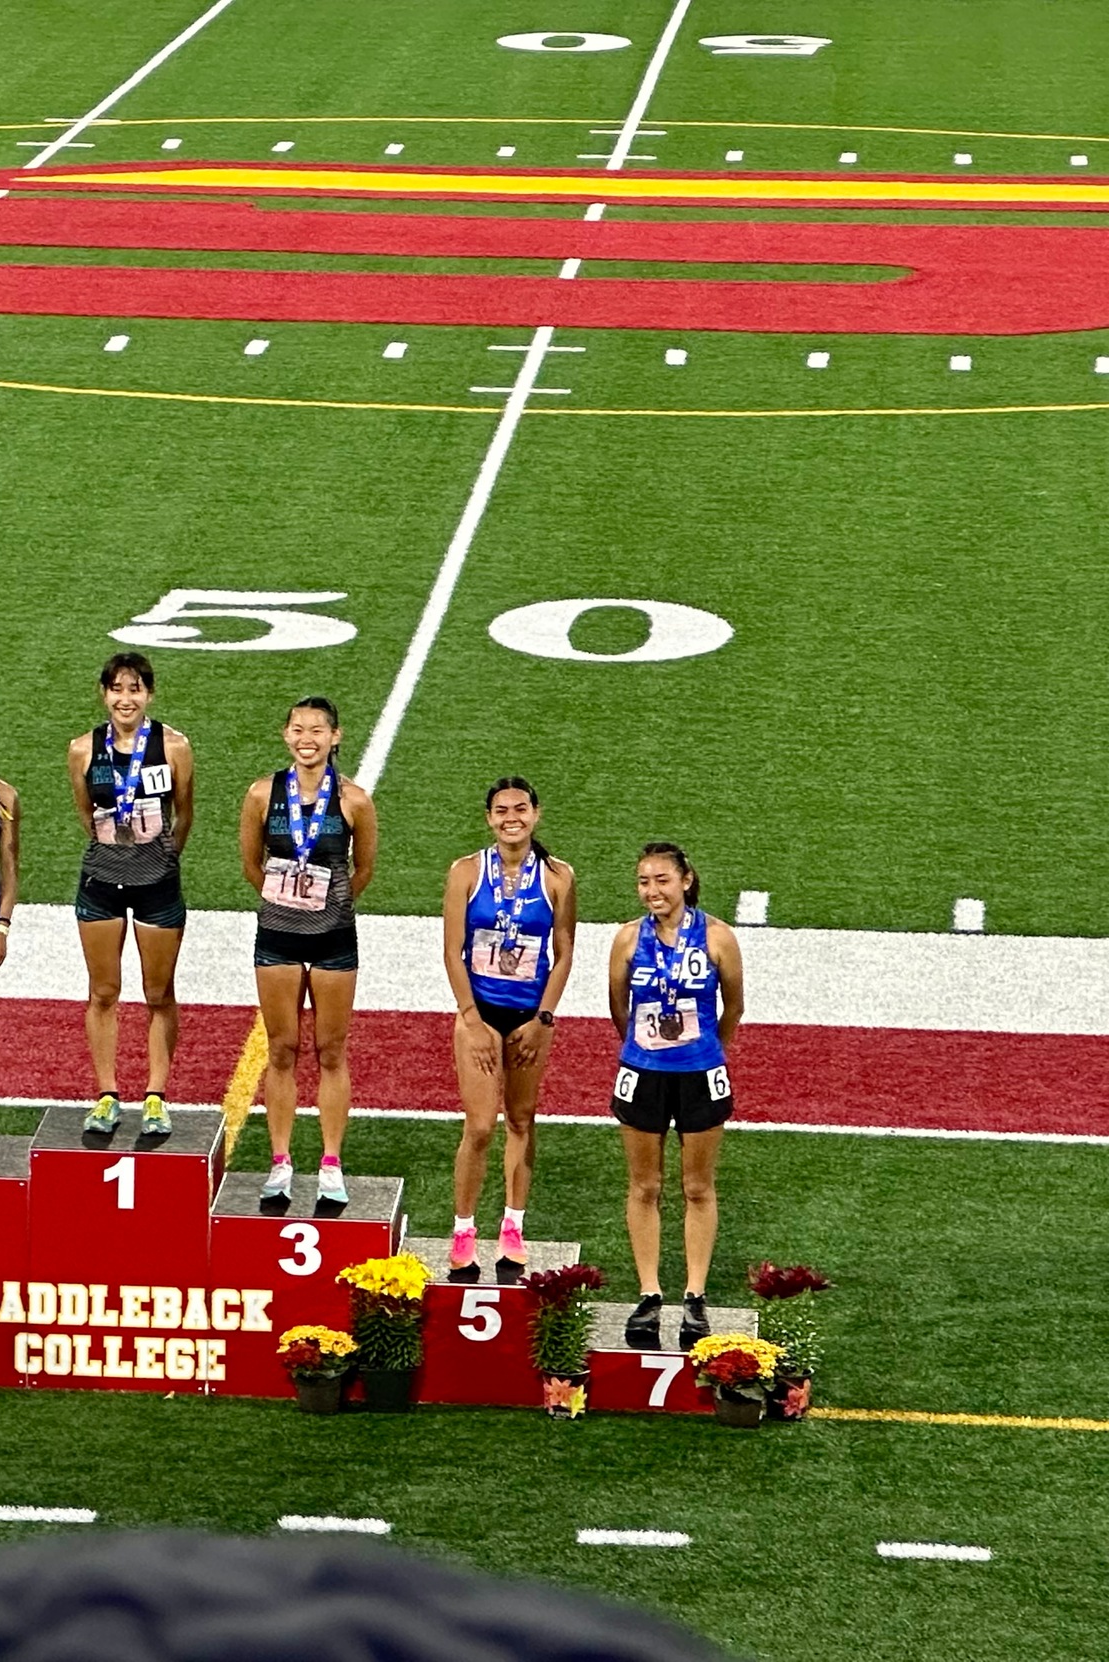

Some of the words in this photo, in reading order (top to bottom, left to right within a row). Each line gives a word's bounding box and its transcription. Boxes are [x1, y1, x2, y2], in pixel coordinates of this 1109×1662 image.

[147, 768, 166, 791] 11
[688, 949, 701, 977] 6
[619, 1071, 633, 1098] 6
[713, 1069, 726, 1096] 6
[103, 1157, 136, 1210] 1
[278, 1223, 322, 1276] 3
[458, 1289, 502, 1341] 5
[14, 1333, 227, 1381] COLLEGE
[640, 1355, 684, 1407] 7
